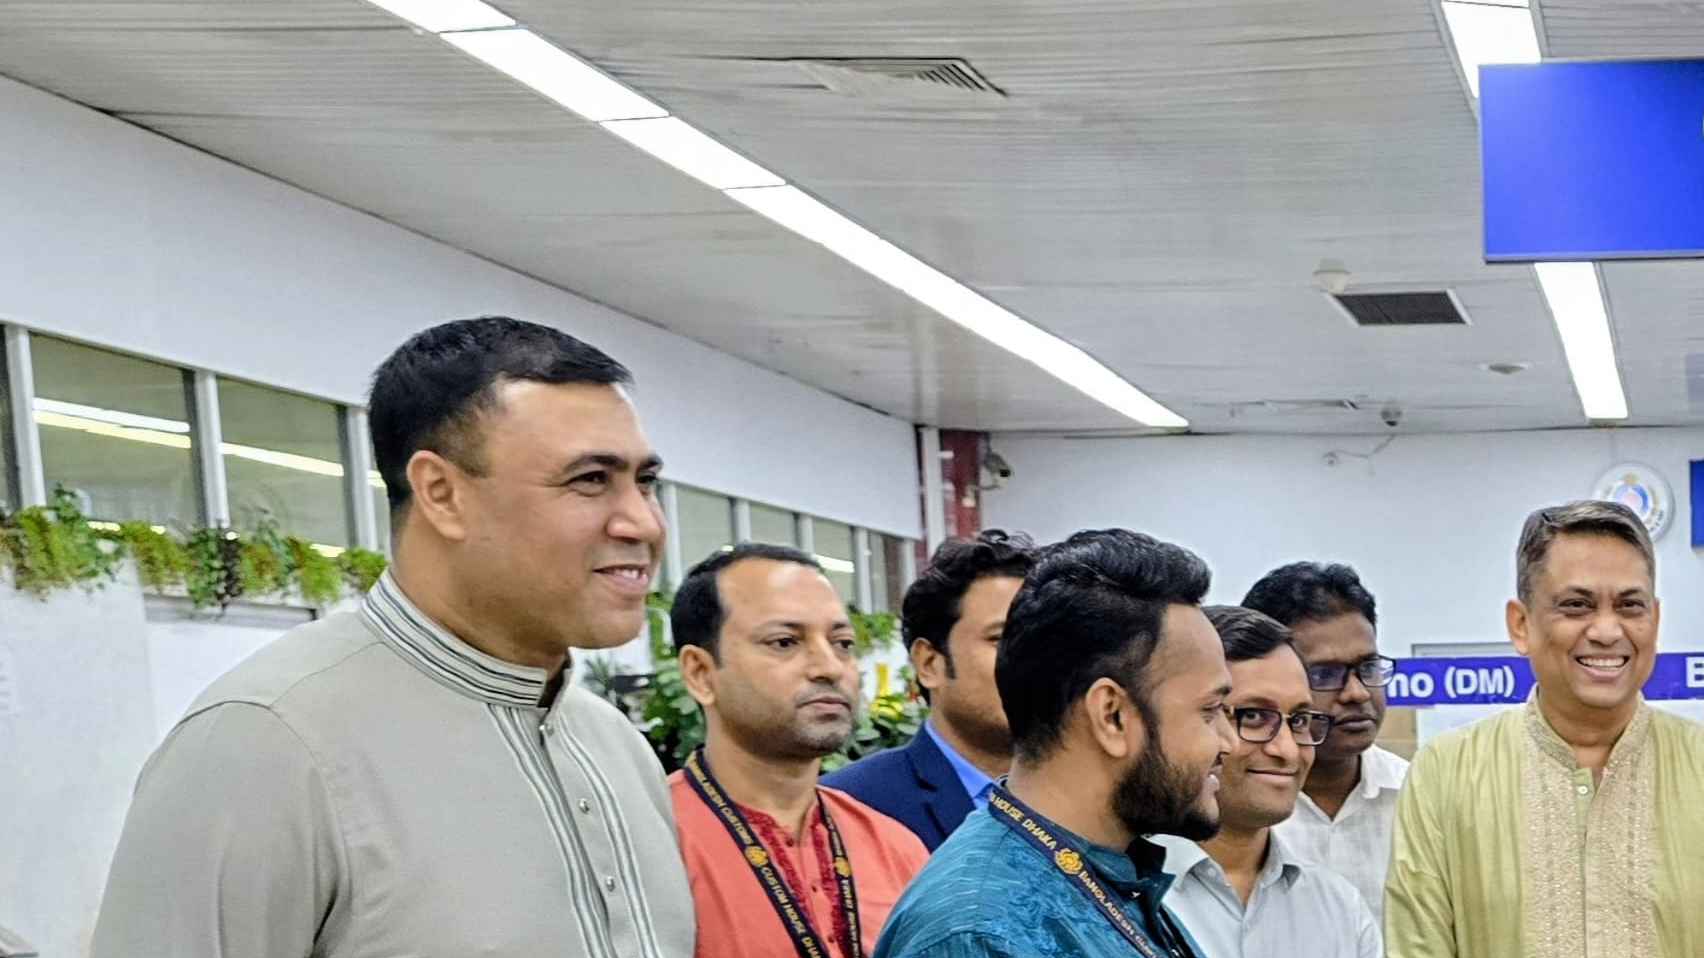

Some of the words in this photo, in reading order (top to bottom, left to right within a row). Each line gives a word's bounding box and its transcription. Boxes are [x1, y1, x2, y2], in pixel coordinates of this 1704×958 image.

[1444, 664, 1516, 699] (DM)
[991, 795, 1025, 821] HOUSE
[1021, 818, 1057, 850] DHAKA
[761, 866, 791, 907] CUSTOM
[783, 903, 807, 935] HOUSE
[1078, 870, 1135, 936] BANGLADESH
